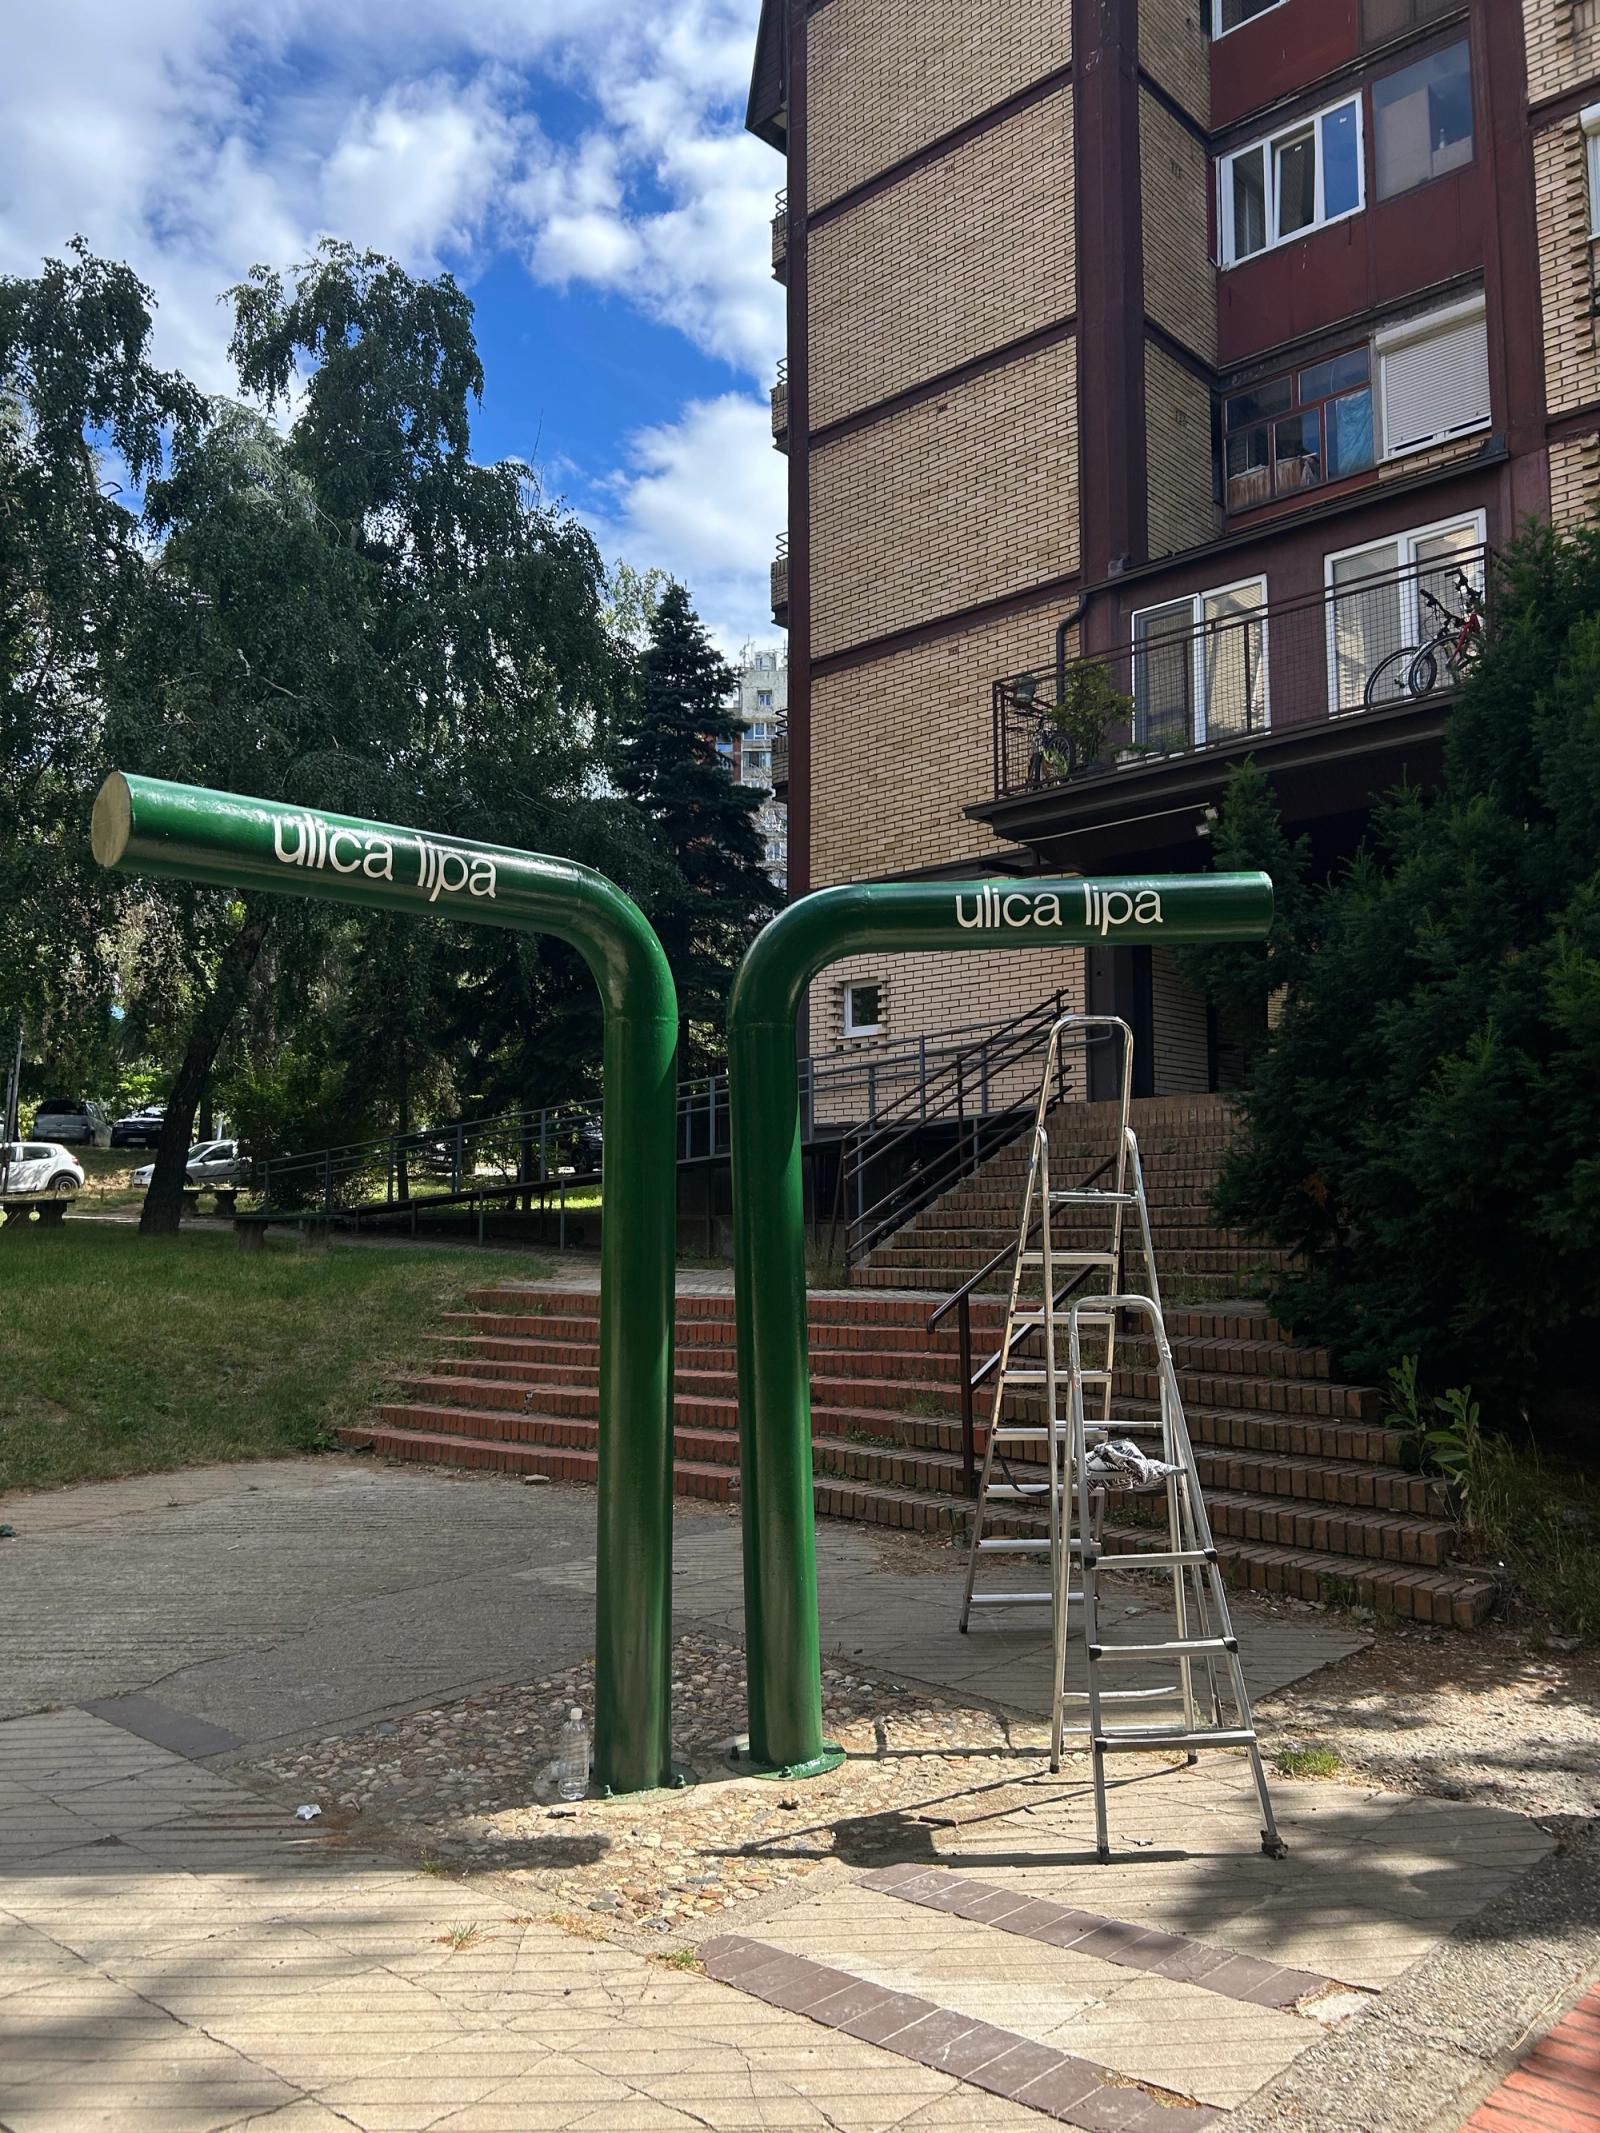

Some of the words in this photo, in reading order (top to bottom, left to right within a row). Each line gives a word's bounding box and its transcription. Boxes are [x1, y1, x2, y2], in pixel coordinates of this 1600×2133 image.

[273, 813, 393, 881] ulica
[415, 835, 496, 902] lipa
[955, 885, 1062, 928] ulica
[1083, 883, 1163, 935] lipa
